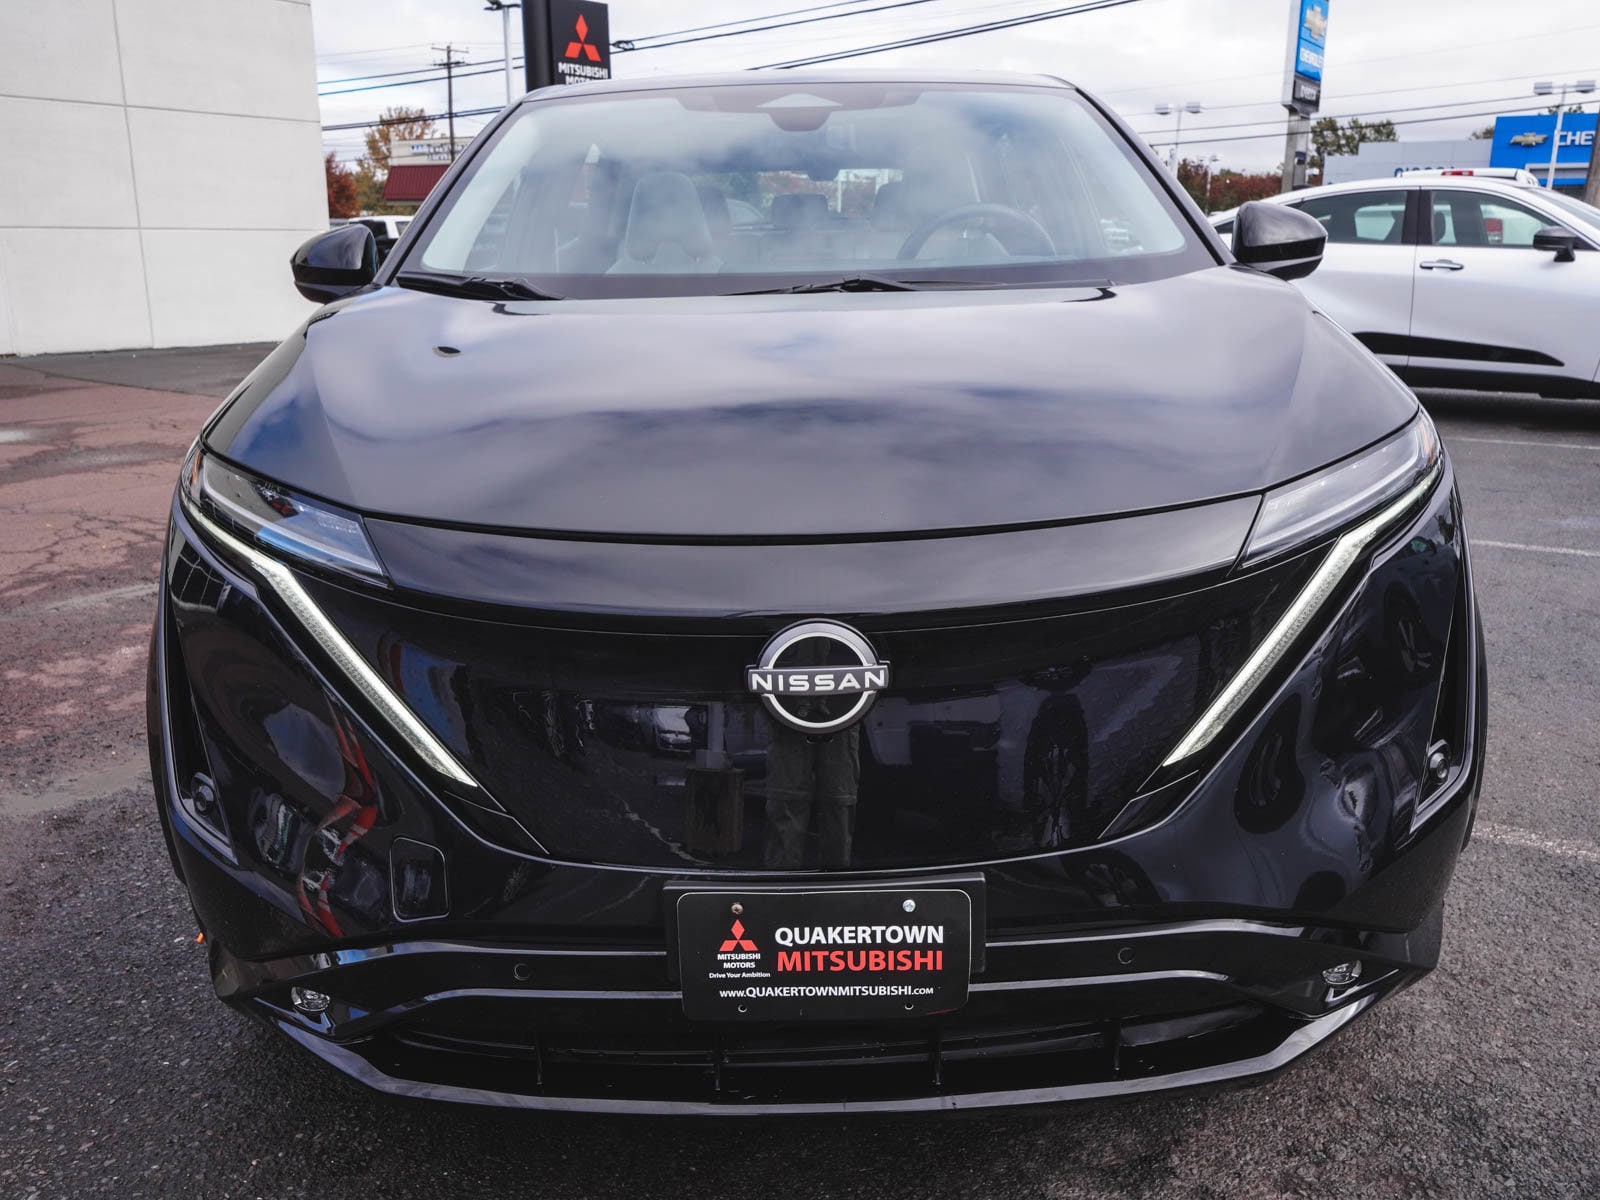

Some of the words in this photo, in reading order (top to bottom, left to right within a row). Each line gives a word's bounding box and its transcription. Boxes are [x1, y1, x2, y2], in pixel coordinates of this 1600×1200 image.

[558, 61, 608, 79] MITSUBISHI
[751, 669, 885, 692] NISSAN
[774, 925, 944, 947] QUAKERTOWN
[717, 953, 761, 961] MITSUBISHI
[777, 950, 943, 972] MITSUBISHI
